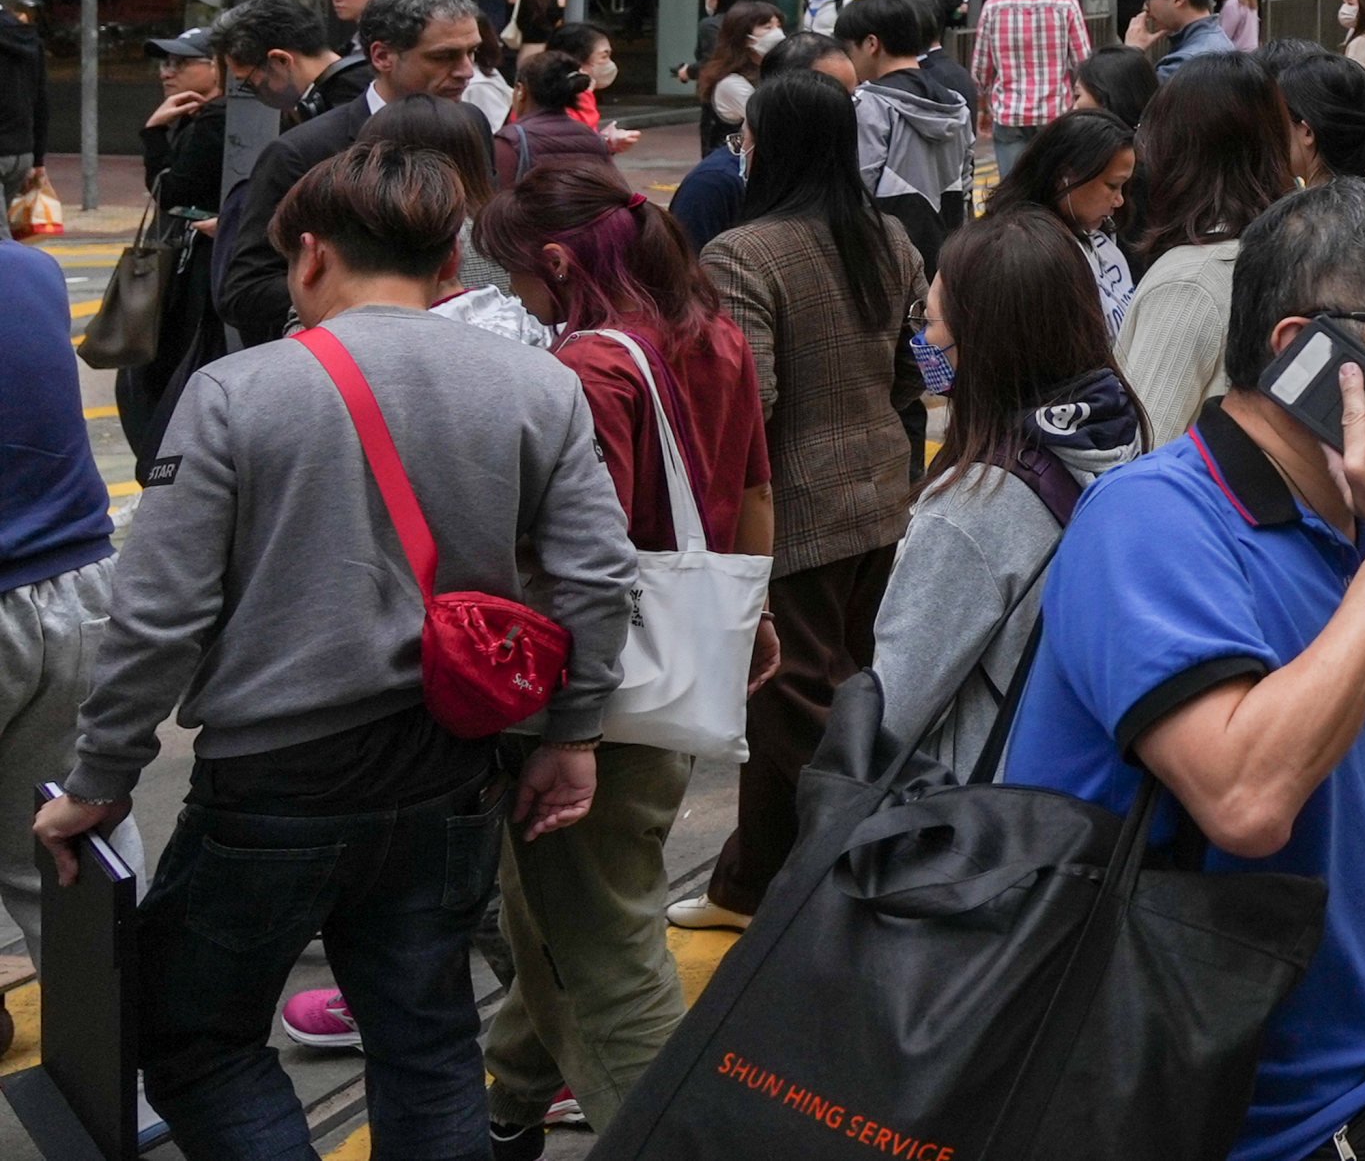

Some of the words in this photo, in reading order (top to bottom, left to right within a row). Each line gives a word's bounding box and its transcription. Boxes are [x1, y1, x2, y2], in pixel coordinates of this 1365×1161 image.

[717, 1051, 785, 1097] SHUN
[783, 1083, 847, 1130] HING
[845, 1114, 956, 1161] SERVICE
